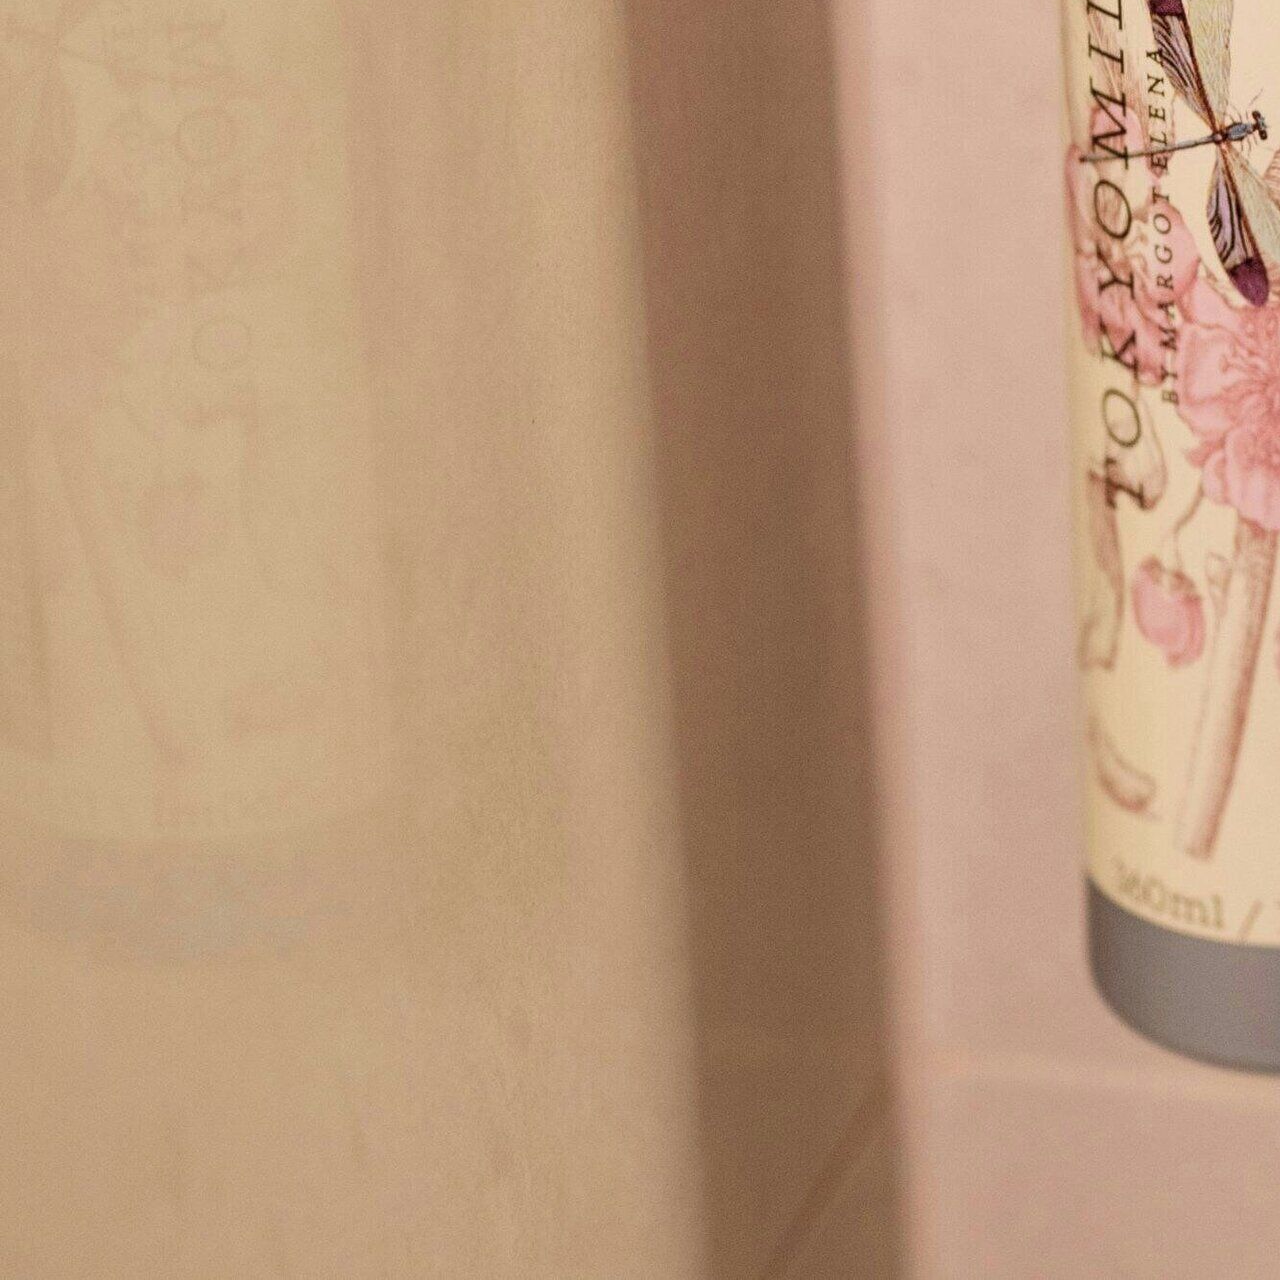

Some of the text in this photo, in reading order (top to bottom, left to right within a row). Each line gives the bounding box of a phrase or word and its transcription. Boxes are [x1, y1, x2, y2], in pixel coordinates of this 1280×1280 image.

[1146, 47, 1180, 405] BY MARGOT ELENA
